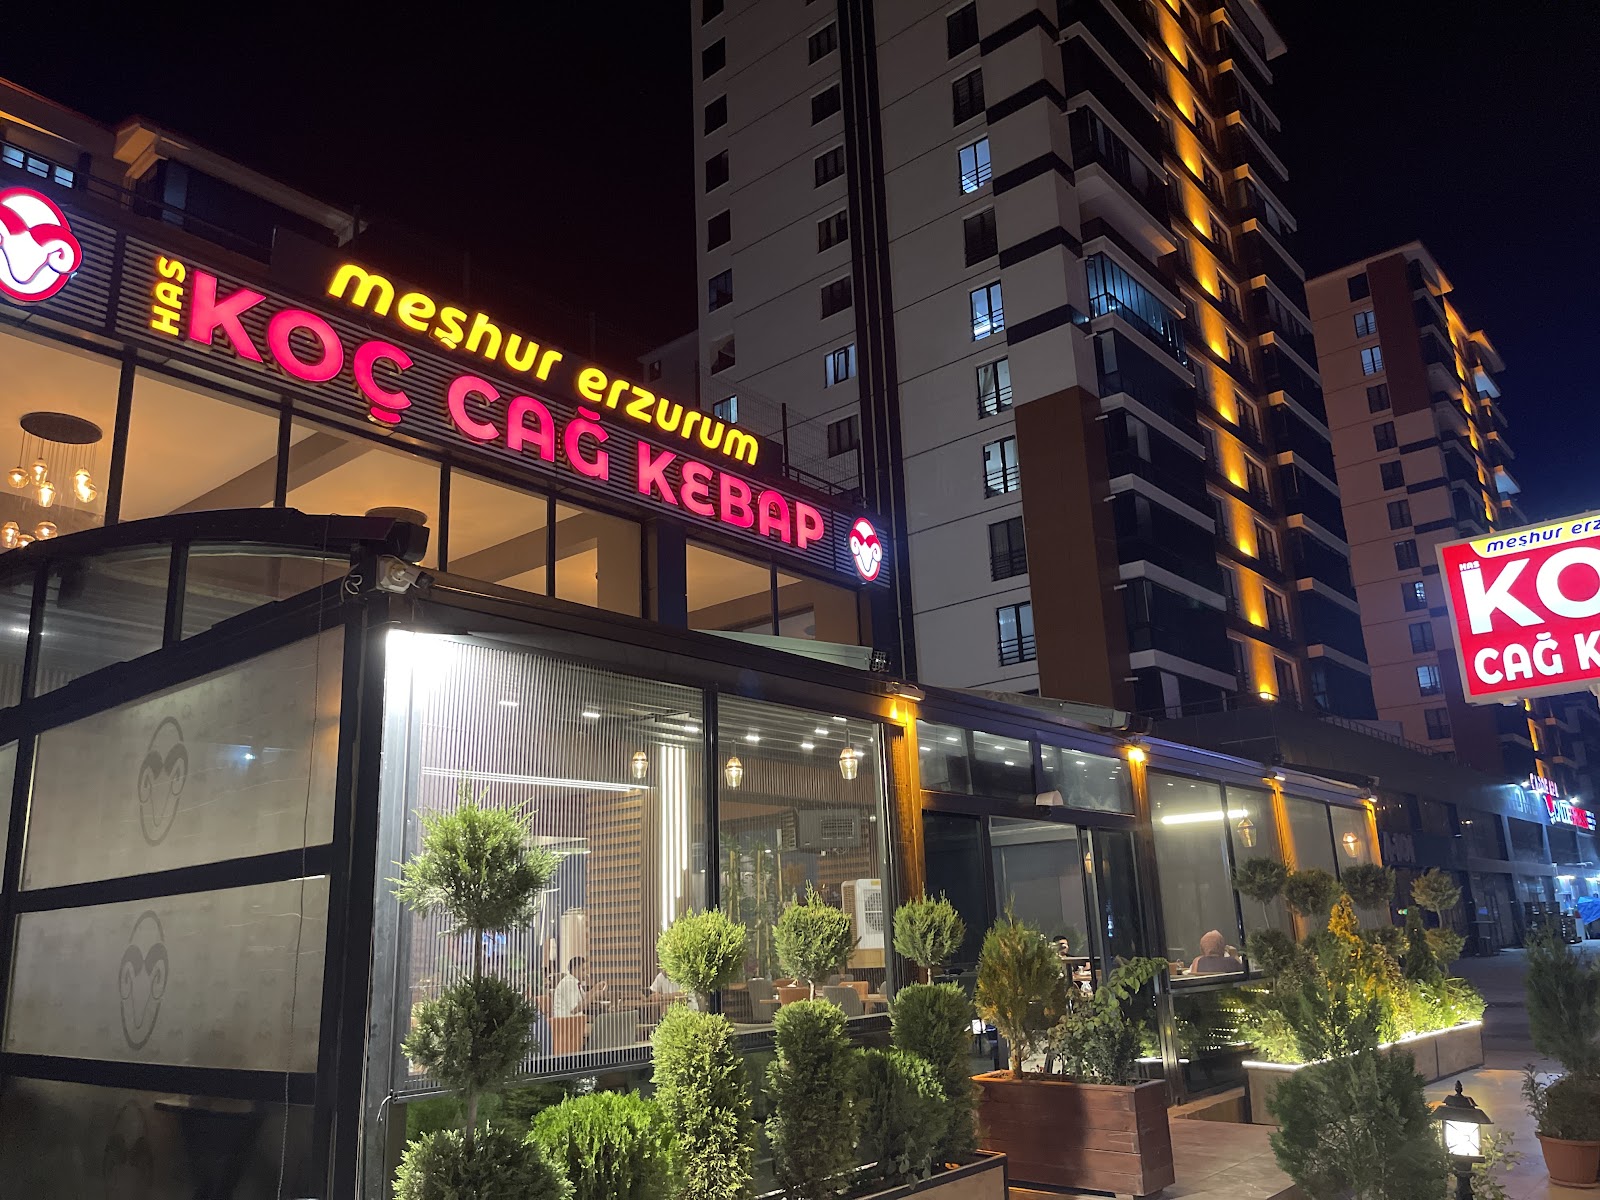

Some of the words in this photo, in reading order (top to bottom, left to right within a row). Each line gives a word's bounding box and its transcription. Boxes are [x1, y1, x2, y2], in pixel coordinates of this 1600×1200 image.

[151, 256, 187, 336] HAS
[328, 264, 563, 381] meşhur
[578, 367, 760, 466] erzurum
[189, 271, 414, 425] KOÇ
[447, 375, 610, 482] CAĞ
[637, 439, 826, 550] KEBAP
[1458, 560, 1480, 570] HAS
[1486, 526, 1563, 553] meşhur
[1474, 631, 1564, 684] CAĞ
